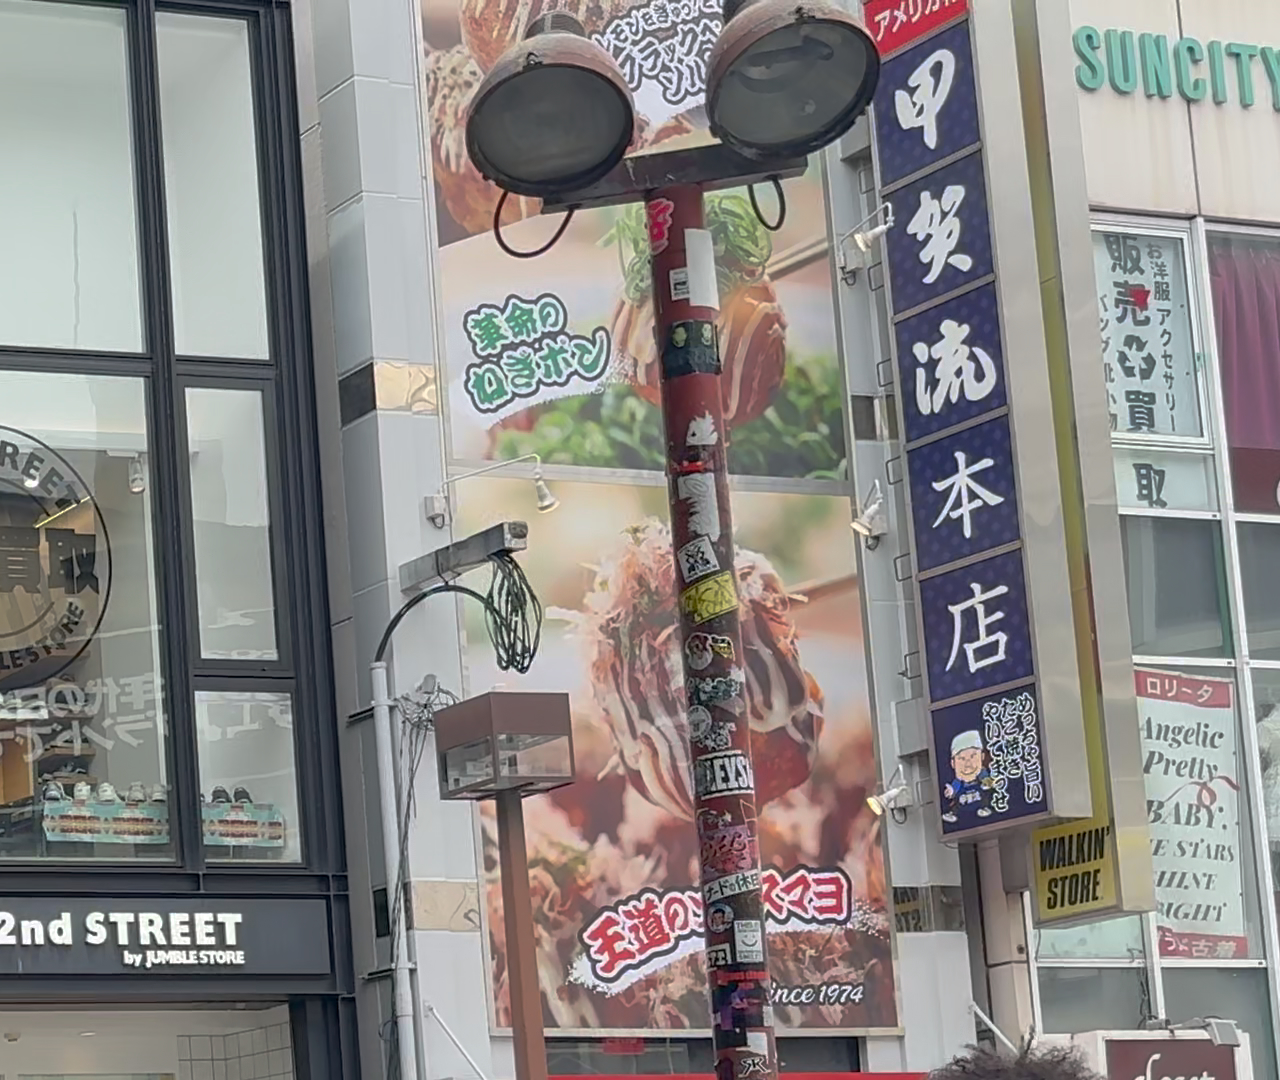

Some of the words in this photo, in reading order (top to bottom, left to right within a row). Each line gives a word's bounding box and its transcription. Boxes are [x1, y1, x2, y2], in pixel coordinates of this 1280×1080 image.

[874, 0, 958, 42] アメリ
[1072, 25, 1280, 112] SUNCITY
[1145, 242, 1171, 302] お洋服
[469, 298, 564, 355] 革命の
[469, 333, 608, 406] ねぎポン
[895, 48, 1011, 673] 甲賀流本店
[1156, 308, 1176, 432] アクセサリー
[1146, 677, 1214, 702] ロリータ
[1001, 698, 1022, 778] たこ焼き
[1017, 692, 1042, 803] めっちゃ旨い
[1141, 716, 1224, 750] Angelic
[982, 702, 1009, 812] やいてまっせ
[1142, 750, 1218, 782] Pretty
[1040, 825, 1110, 872] WALKIN'
[1173, 840, 1235, 862] STARS
[1047, 869, 1101, 910] STORE
[1155, 870, 1217, 890] HINE
[85, 912, 242, 946] STREET
[584, 872, 845, 975] 王道のスマヨ
[123, 951, 142, 966] by
[769, 988, 815, 1003] ince
[818, 984, 864, 1002] 1974
